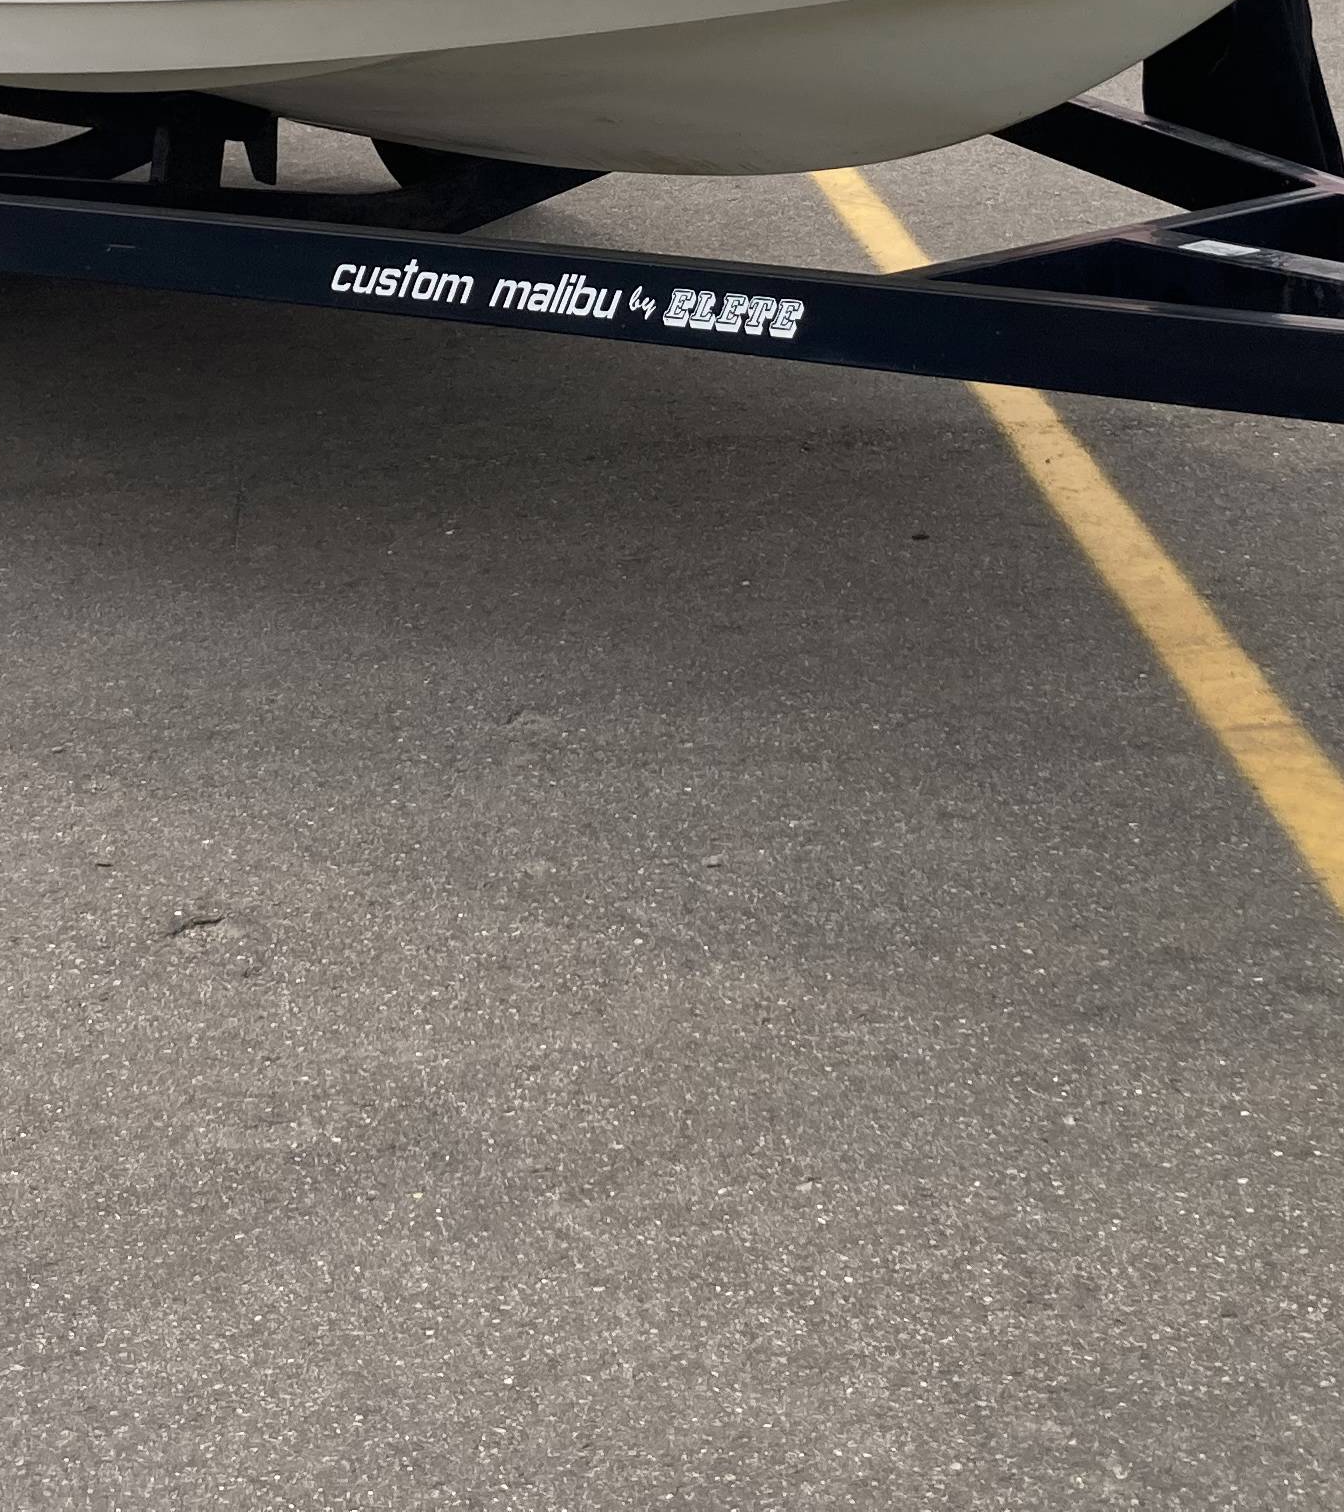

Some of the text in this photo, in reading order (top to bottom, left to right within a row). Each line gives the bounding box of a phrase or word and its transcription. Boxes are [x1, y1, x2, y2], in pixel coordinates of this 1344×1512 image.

[330, 258, 805, 339] custom malibu by ELETE
